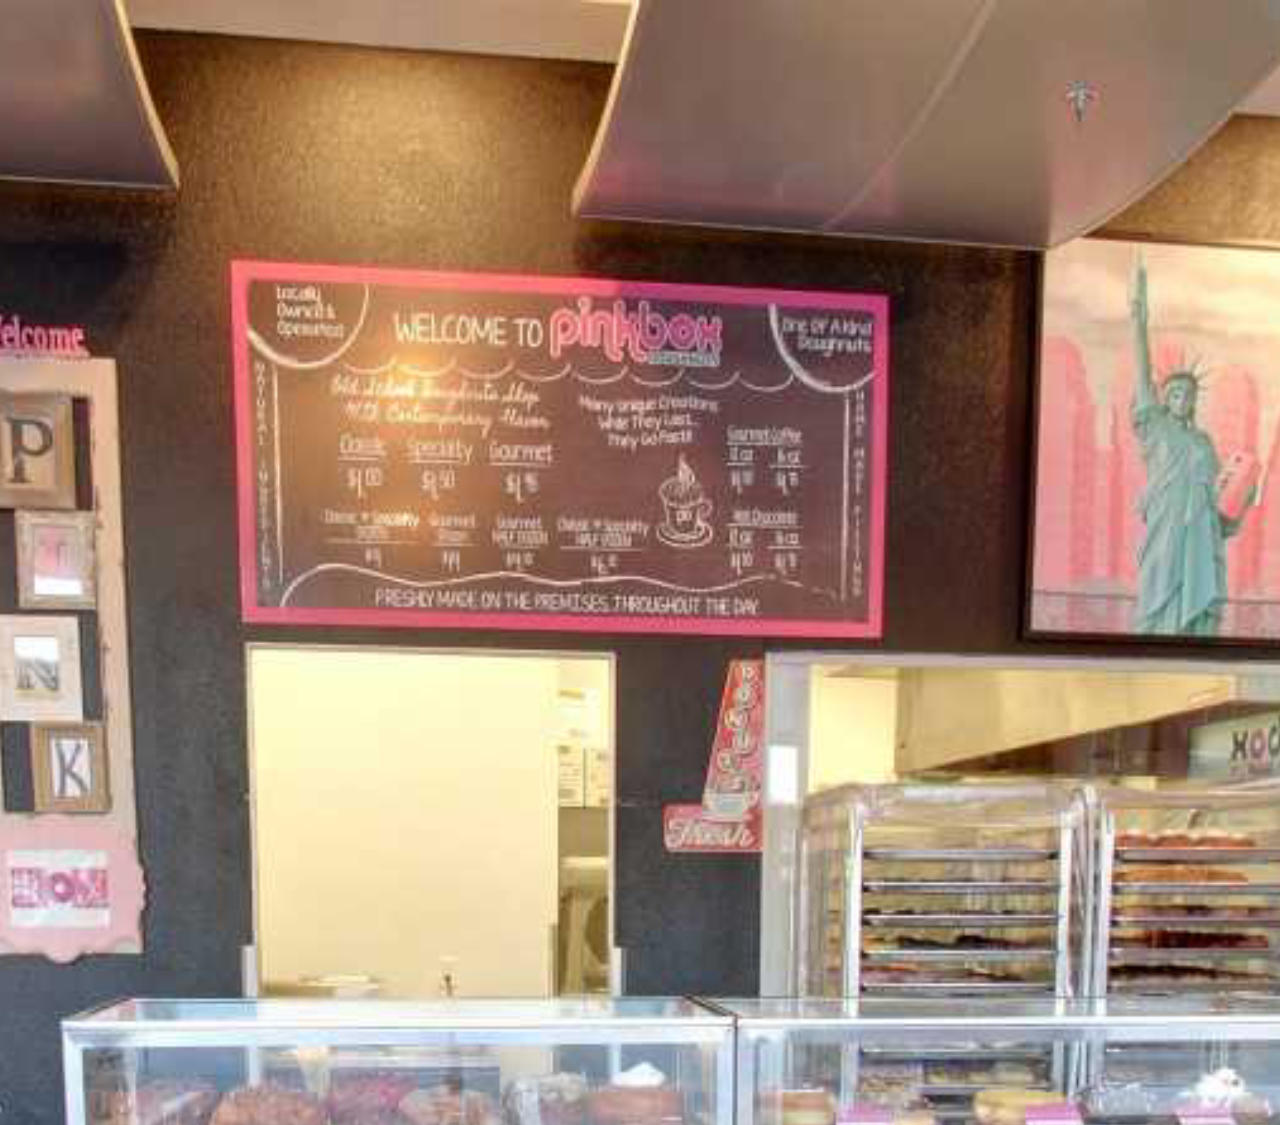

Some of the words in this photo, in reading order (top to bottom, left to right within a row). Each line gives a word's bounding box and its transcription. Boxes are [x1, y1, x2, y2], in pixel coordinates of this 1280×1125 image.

[392, 312, 508, 346] WELCOME
[513, 318, 544, 348] TO
[550, 296, 724, 364] pinkbox
[797, 336, 873, 359] Doughnuts
[406, 435, 474, 465] Specialty
[487, 440, 554, 464] Gourmet
[375, 588, 435, 608] FRESHLY
[436, 589, 478, 609] MADE
[480, 591, 502, 609] ON
[505, 591, 532, 611] THE
[613, 594, 700, 615] THROUGHOUT
[706, 596, 730, 616] THE
[733, 597, 759, 616] DAY
